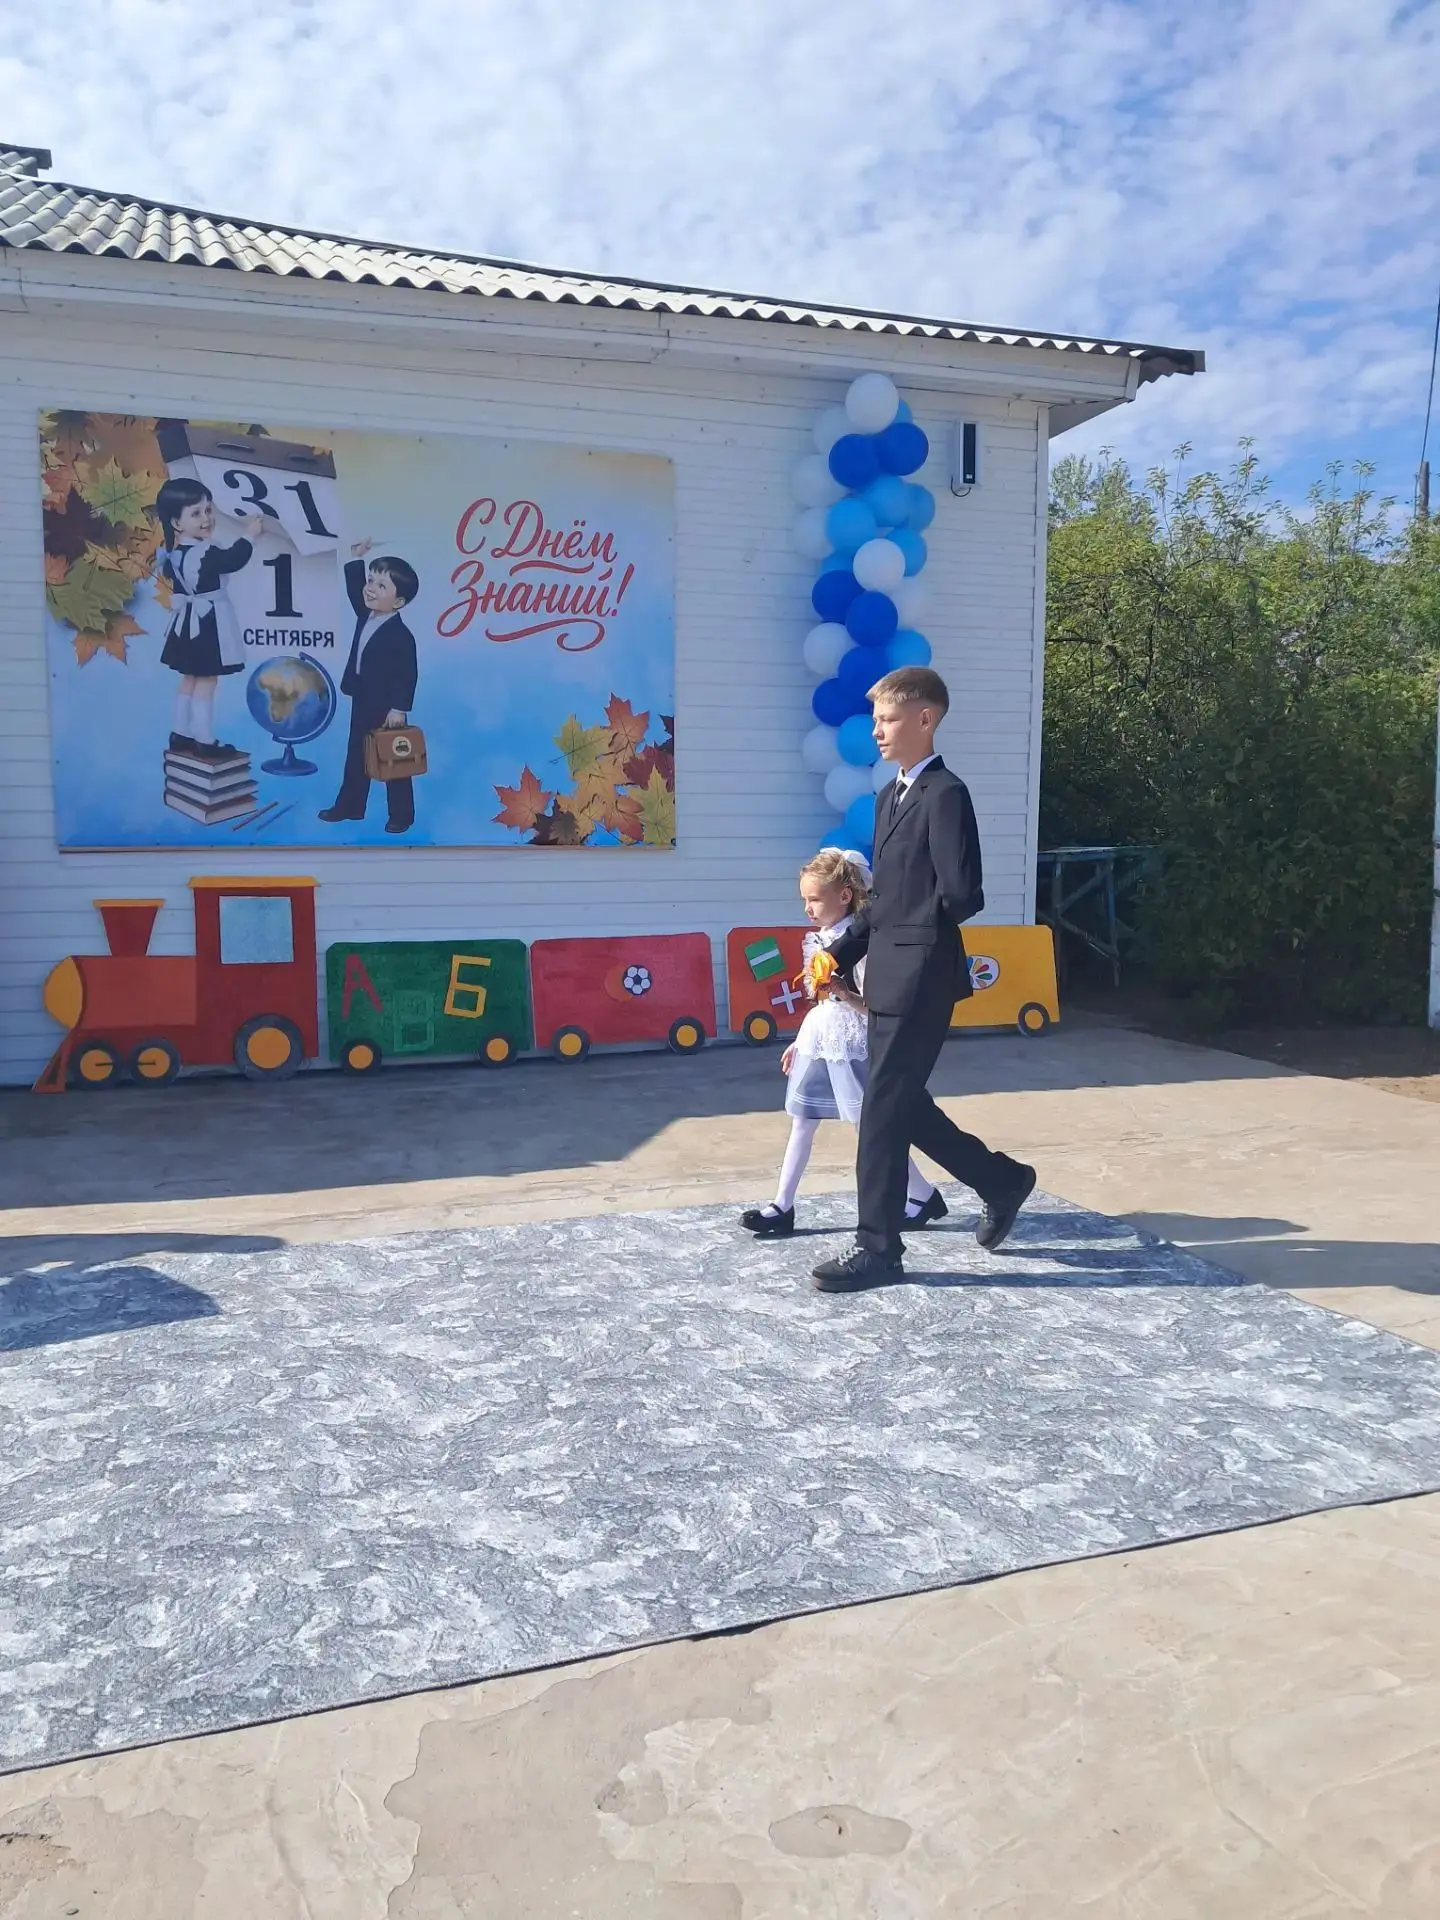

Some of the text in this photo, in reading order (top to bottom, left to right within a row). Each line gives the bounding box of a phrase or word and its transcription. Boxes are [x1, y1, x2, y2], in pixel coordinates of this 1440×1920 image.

[223, 469, 338, 538] 31
[456, 497, 618, 563] С Днём
[263, 553, 303, 618] 1
[437, 560, 635, 638] Знаний!
[243, 628, 335, 648] СЕНТЯБРЯ
[341, 953, 384, 1021] А
